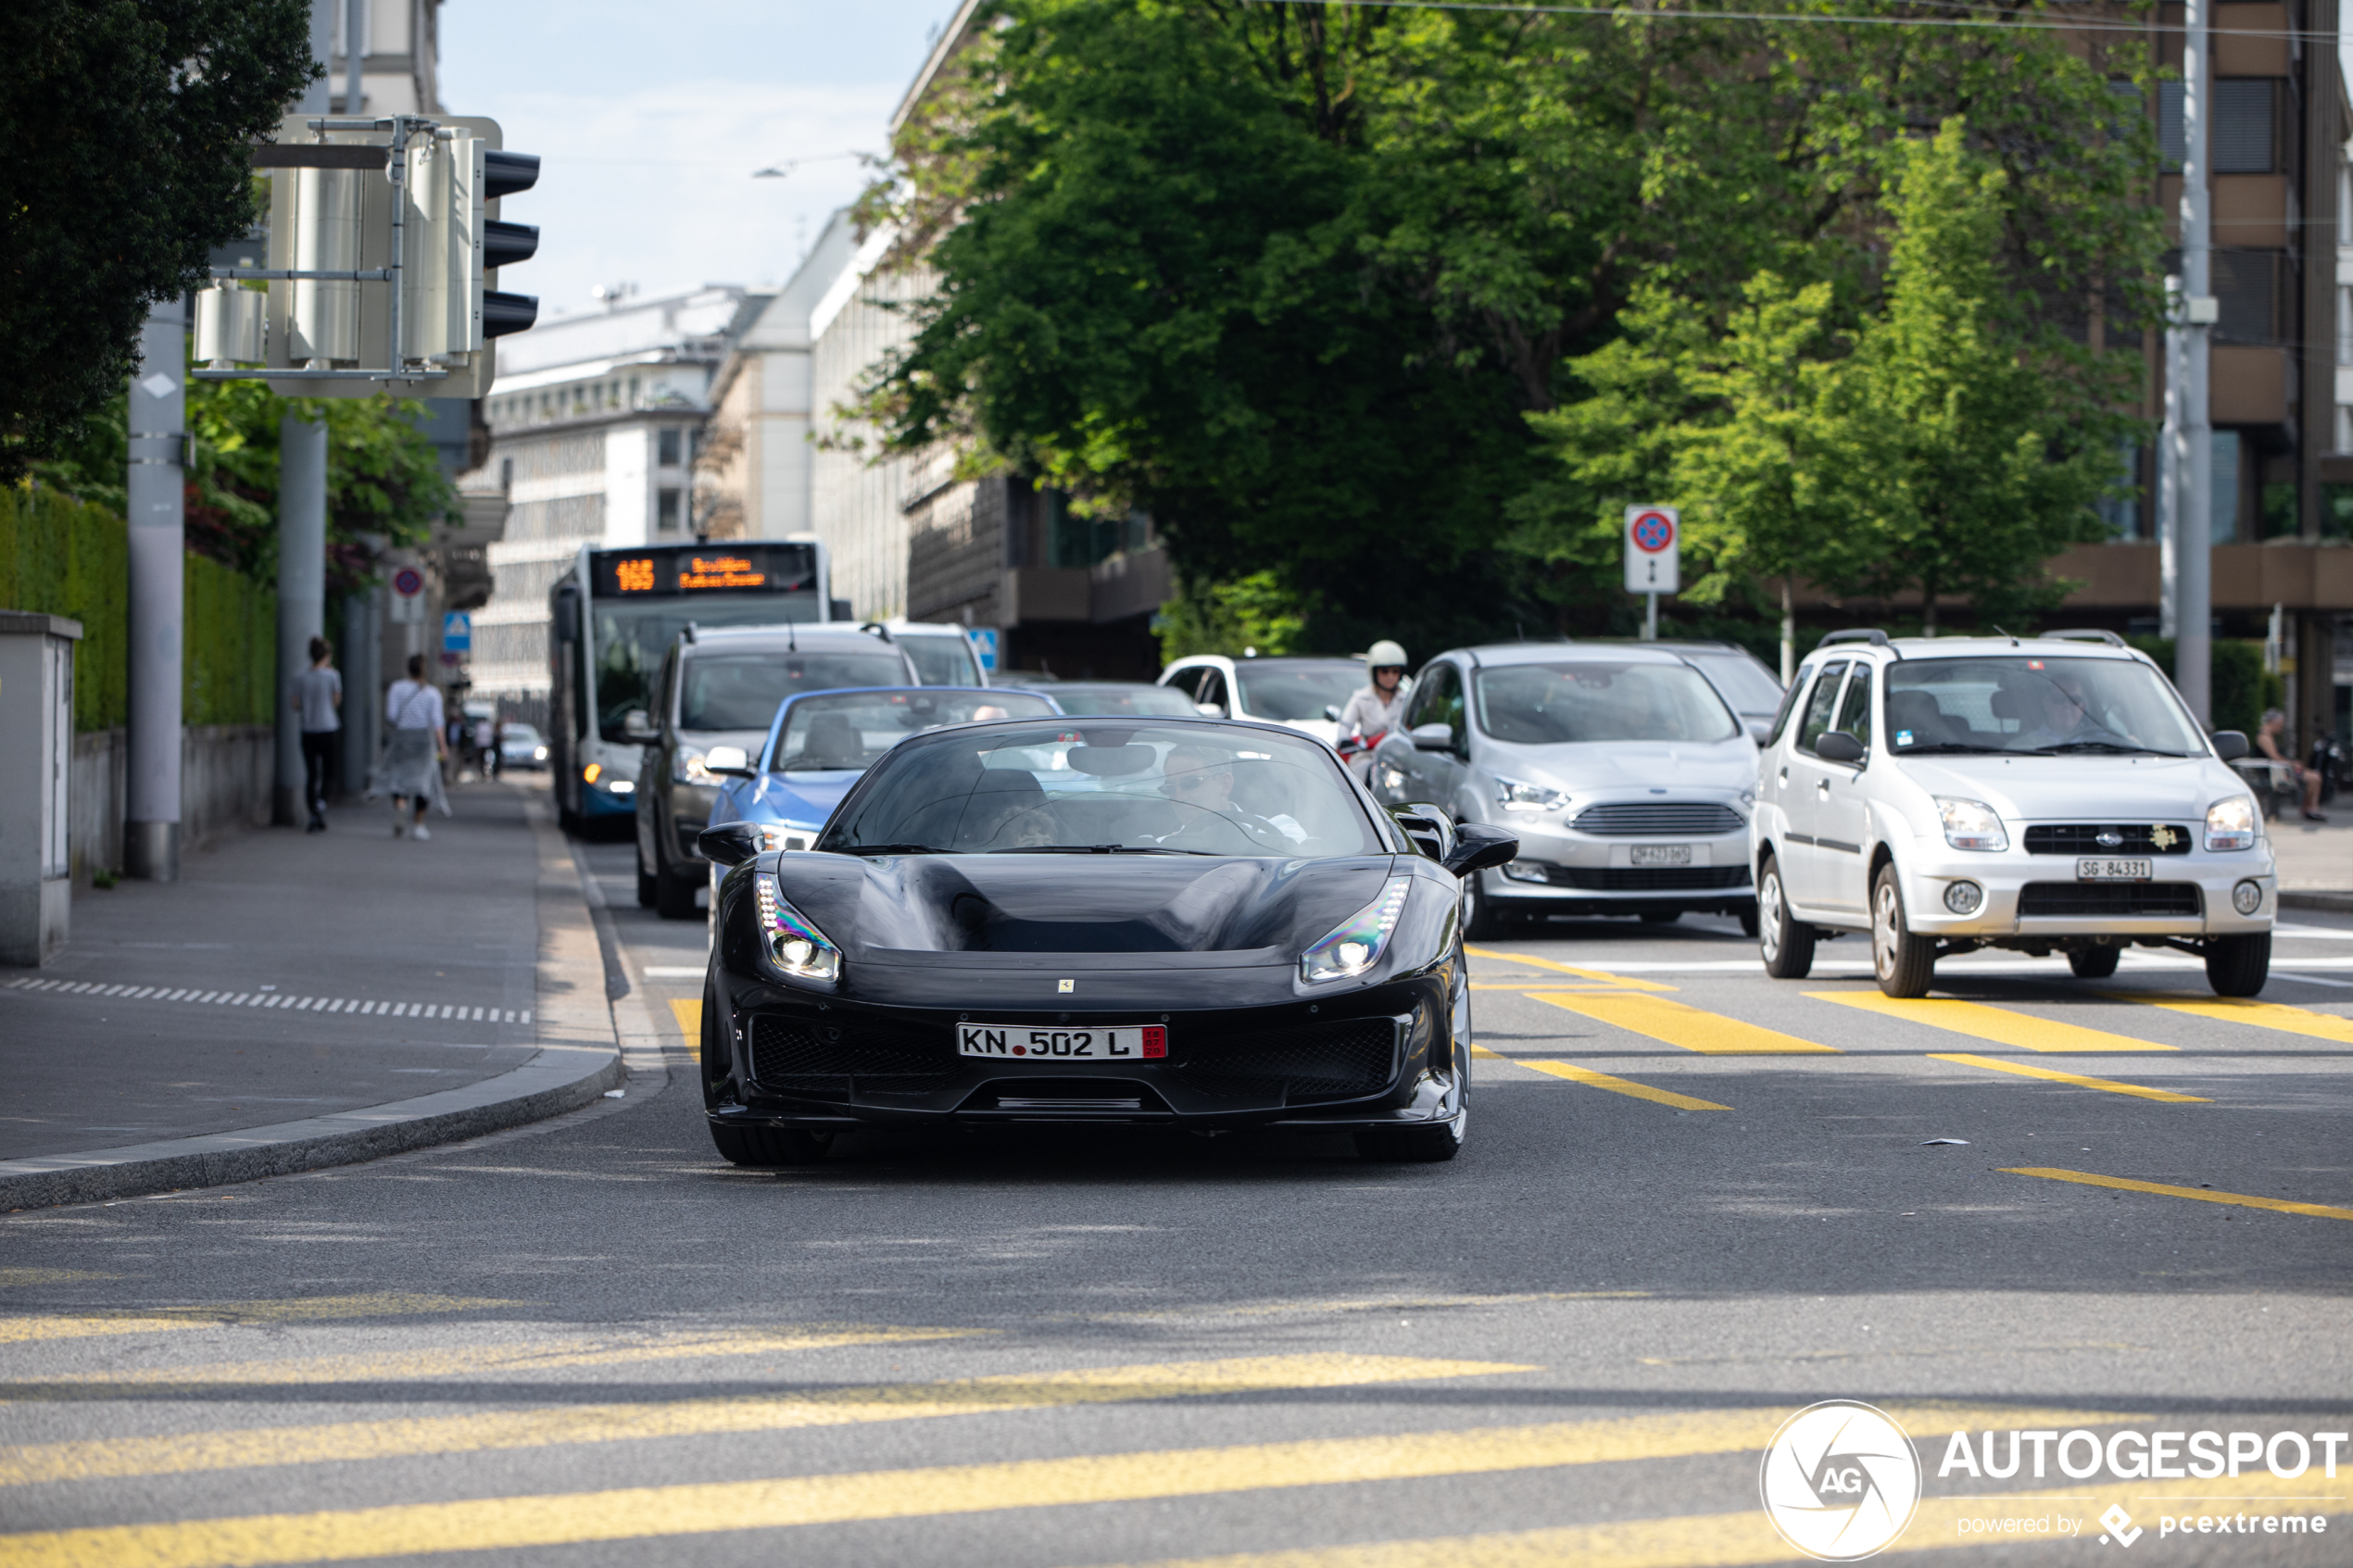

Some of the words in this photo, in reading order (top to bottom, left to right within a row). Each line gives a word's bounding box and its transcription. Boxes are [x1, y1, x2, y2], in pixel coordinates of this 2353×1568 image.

[2107, 861, 2145, 875] 84331
[963, 1028, 1007, 1054] KN
[1029, 1032, 1093, 1057] 502
[1108, 1032, 1130, 1056] L
